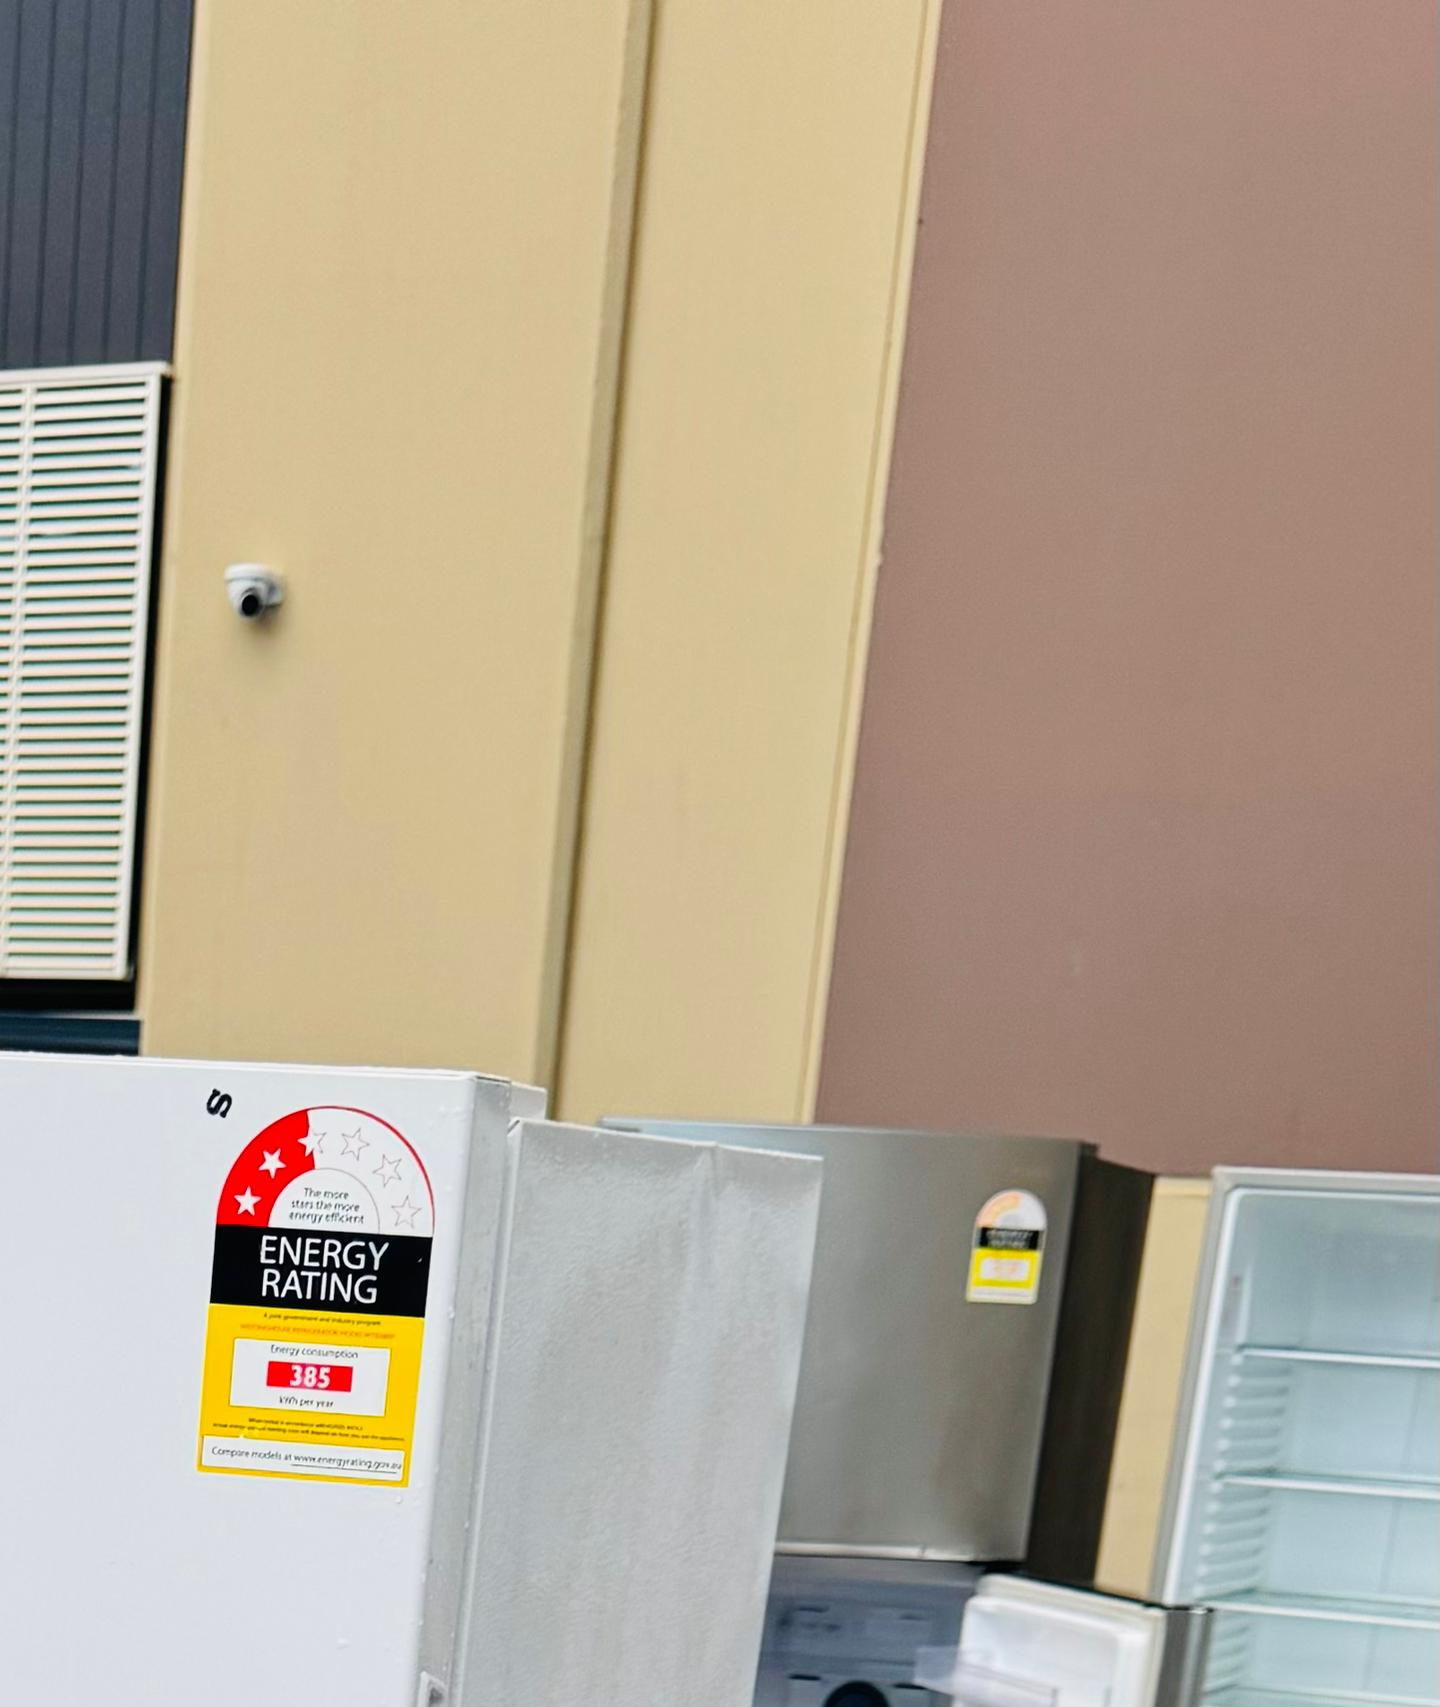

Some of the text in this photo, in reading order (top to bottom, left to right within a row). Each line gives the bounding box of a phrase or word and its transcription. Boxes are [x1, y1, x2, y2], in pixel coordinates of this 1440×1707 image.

[304, 1187, 349, 1200] The more
[291, 1200, 360, 1212] stars the more
[289, 1212, 364, 1224] energy efficient
[260, 1235, 389, 1271] ENERGY
[262, 1268, 378, 1304] RATING
[270, 1344, 358, 1359] Energy consumption
[290, 1364, 331, 1389] 385
[212, 1446, 250, 1458] Compare
[251, 1450, 282, 1460] models
